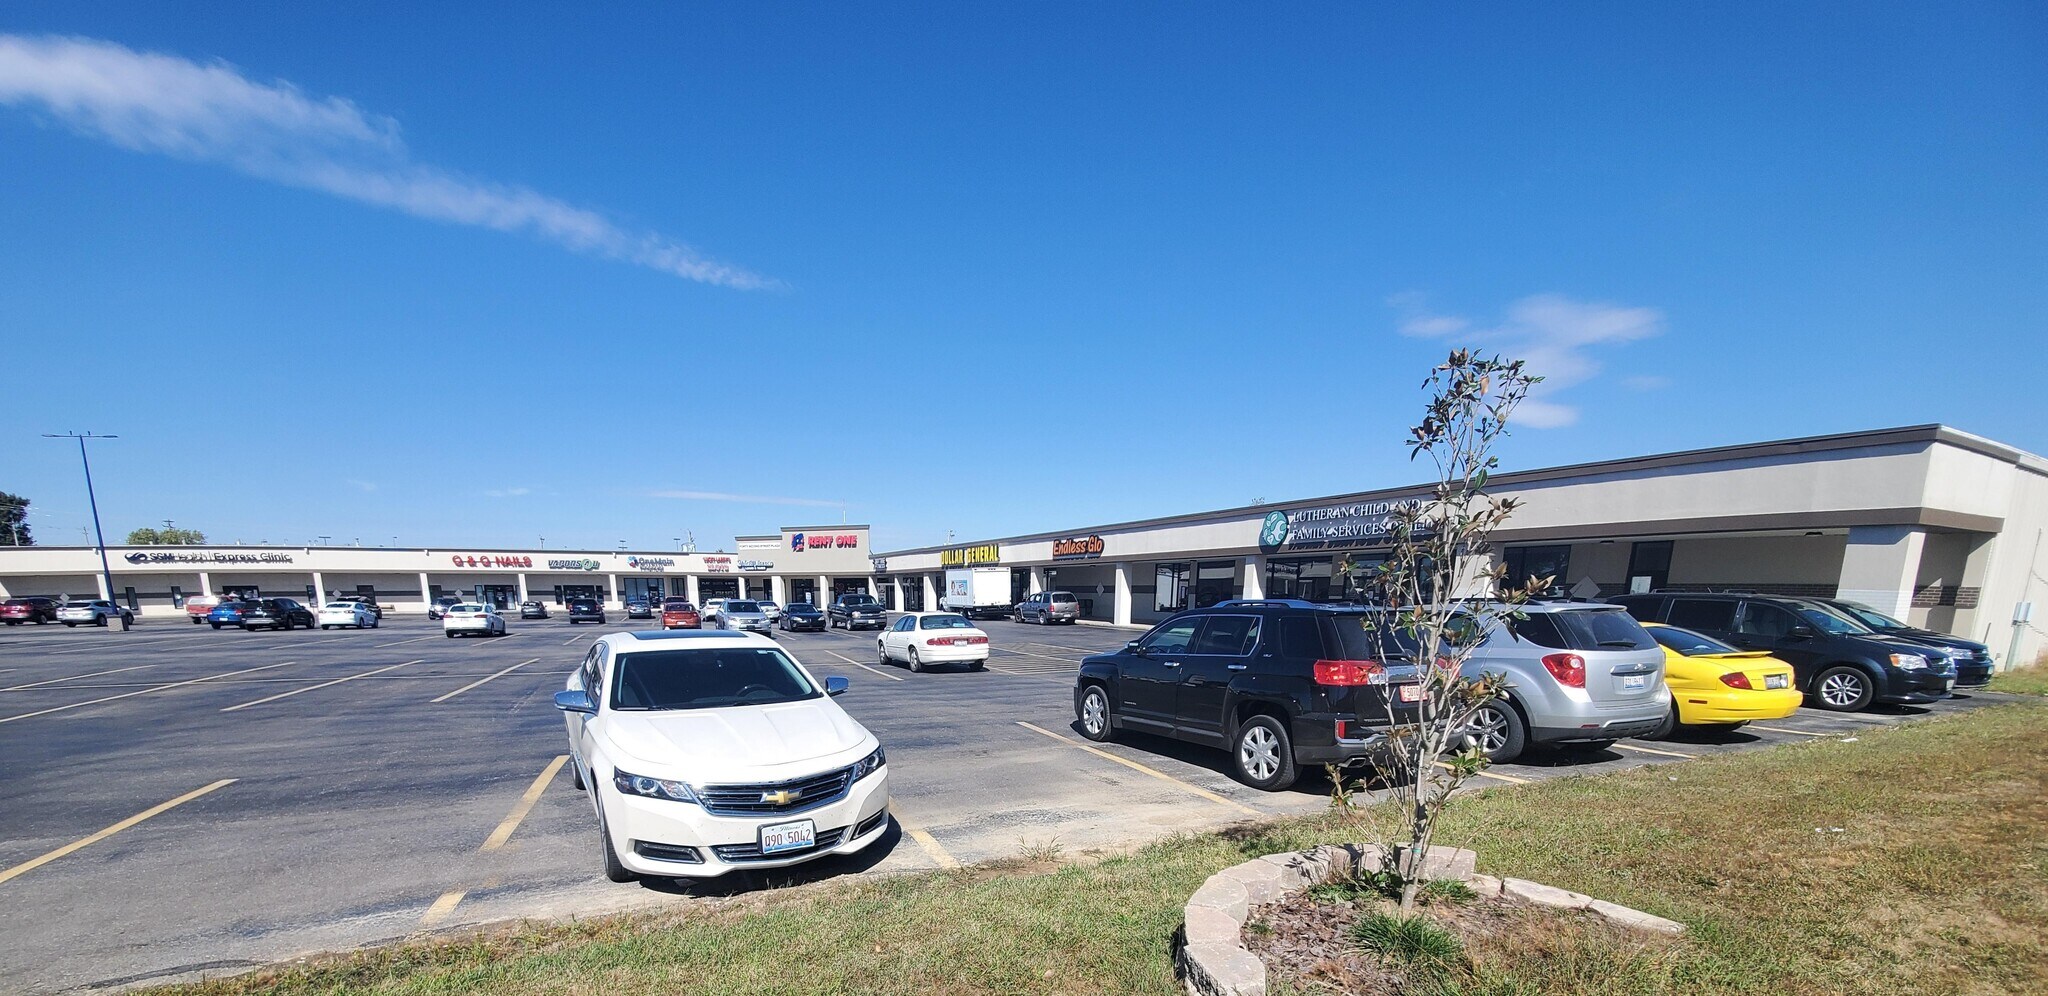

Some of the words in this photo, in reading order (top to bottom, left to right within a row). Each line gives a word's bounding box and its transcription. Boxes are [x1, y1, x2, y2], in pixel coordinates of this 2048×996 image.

[1293, 506, 1351, 522] LUTHERAN
[1352, 502, 1390, 517] CHILD
[1394, 498, 1421, 513] ND
[1292, 526, 1330, 540] FAMILY
[1331, 522, 1387, 538] SERVICES
[808, 535, 833, 547] RENT
[836, 535, 857, 547] ONE
[1053, 539, 1087, 555] Endless
[1088, 535, 1102, 552] Glo
[213, 552, 258, 564] Express
[260, 552, 293, 563] Clinic
[495, 555, 533, 568] NAILS
[941, 549, 964, 565] DOLLAR
[966, 544, 999, 563] GENERAL
[787, 828, 812, 844] 5042
